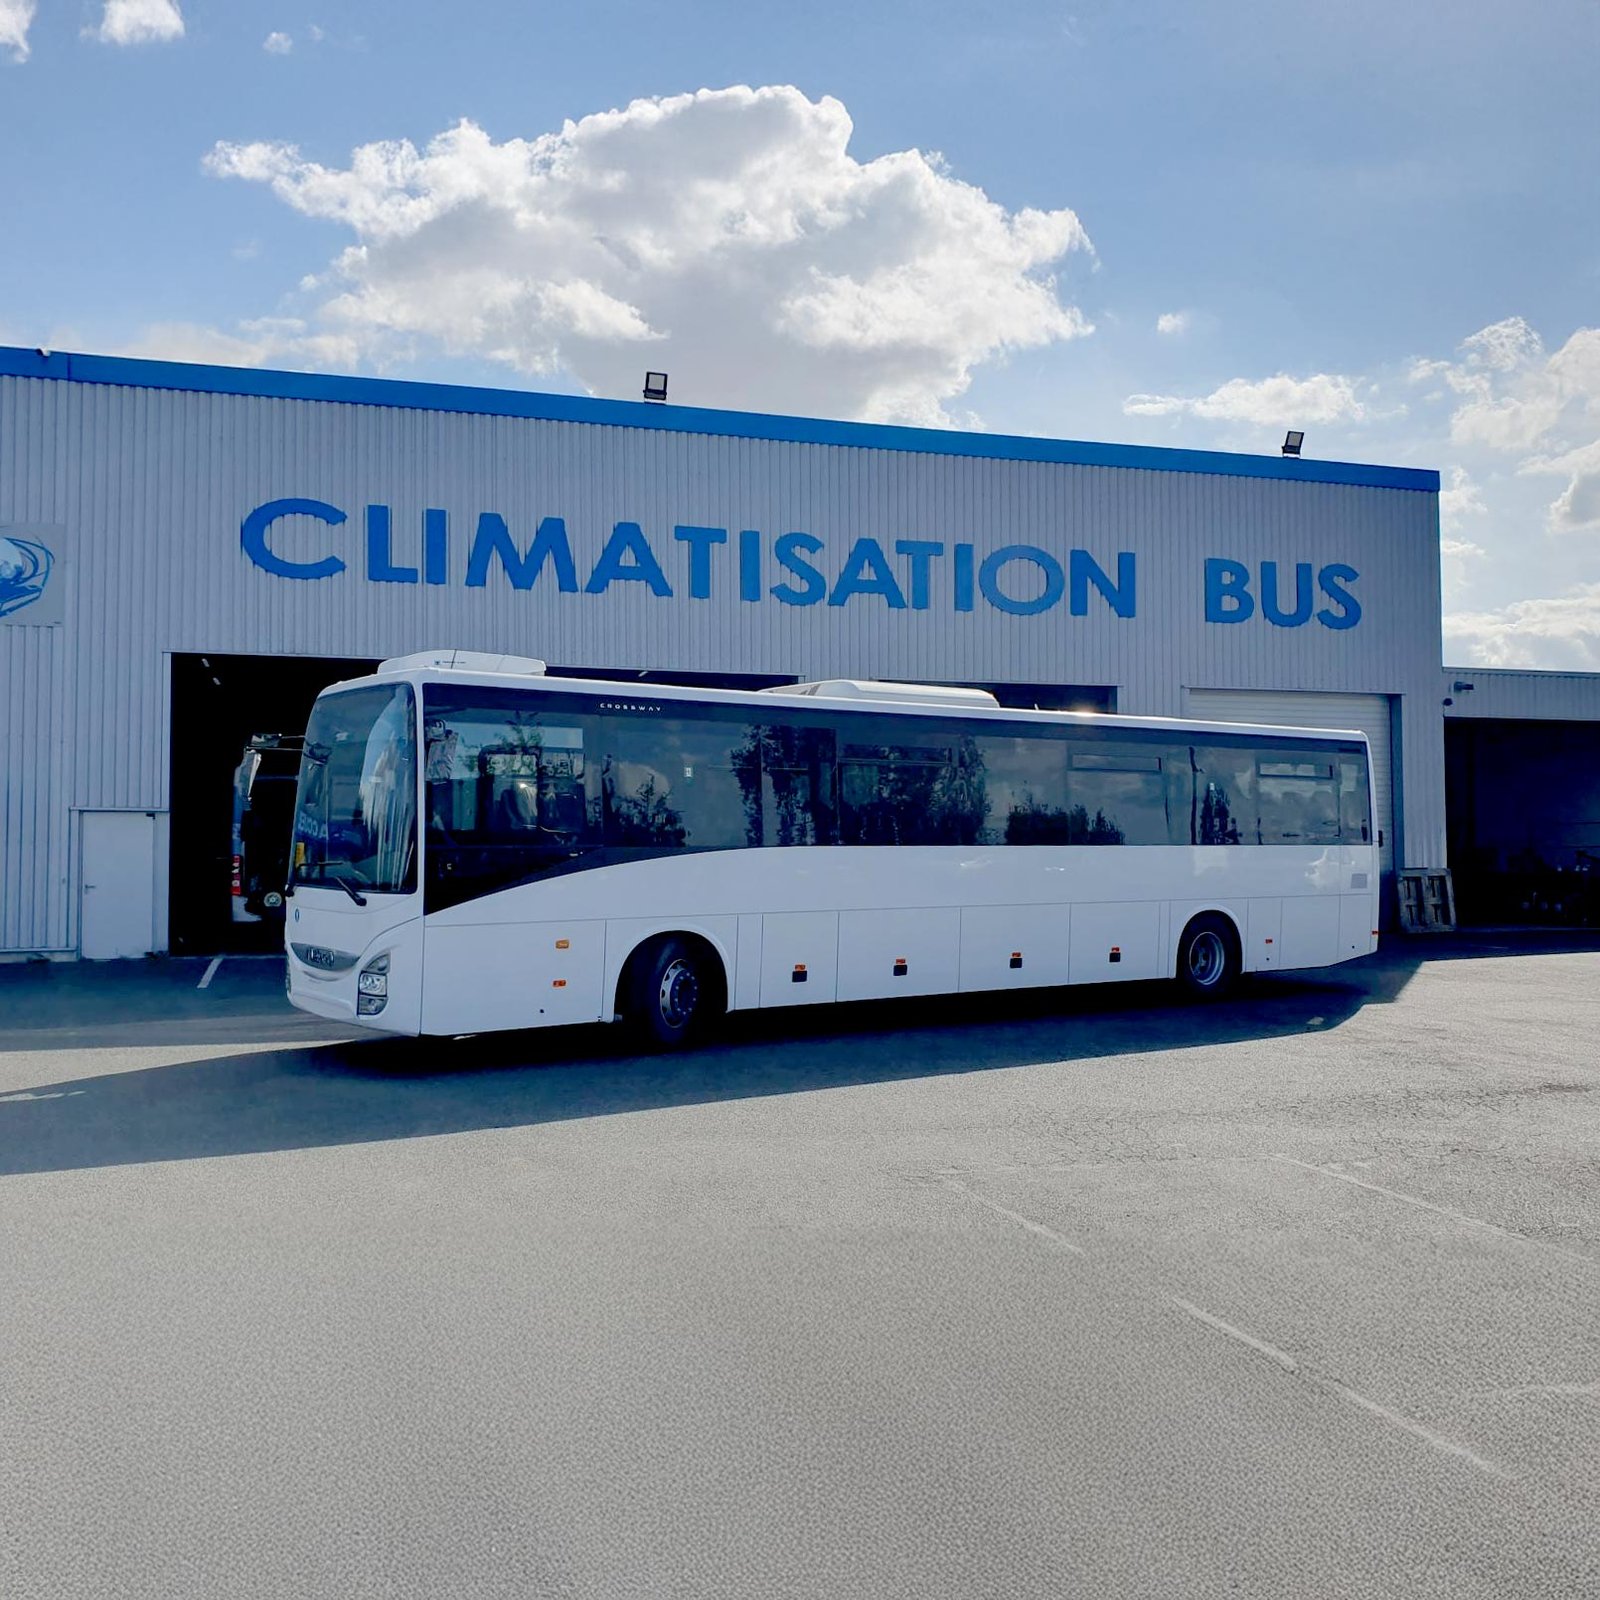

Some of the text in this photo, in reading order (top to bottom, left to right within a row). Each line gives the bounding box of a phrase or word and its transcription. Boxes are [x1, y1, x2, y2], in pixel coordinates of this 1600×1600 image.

[240, 498, 1362, 631] CLIMATISATION BUS
[599, 702, 662, 712] CROSSWAY
